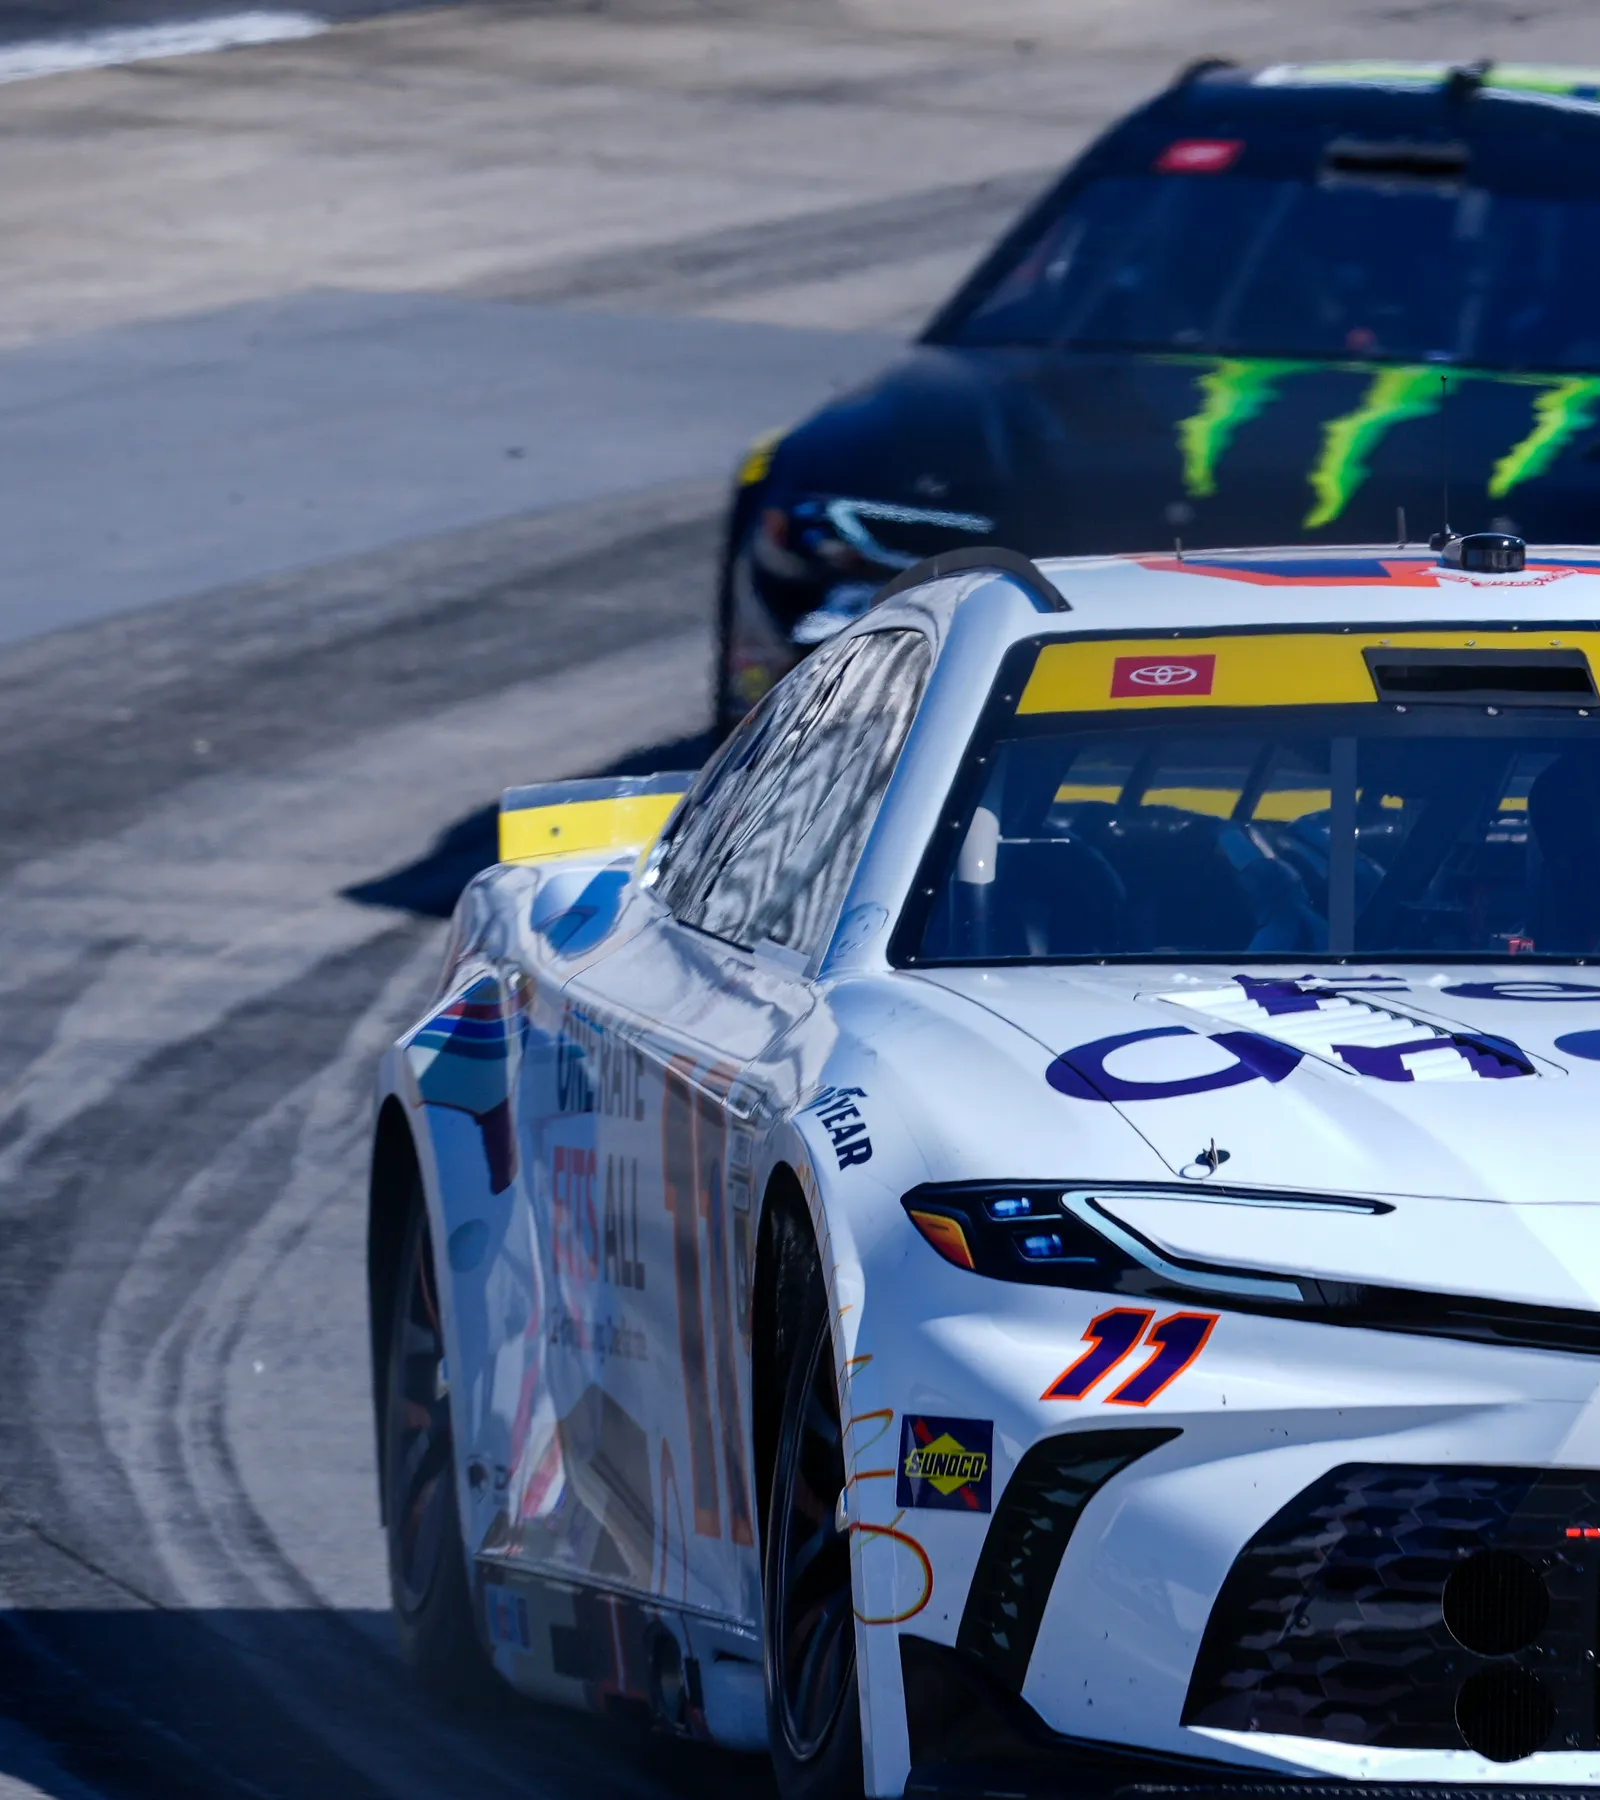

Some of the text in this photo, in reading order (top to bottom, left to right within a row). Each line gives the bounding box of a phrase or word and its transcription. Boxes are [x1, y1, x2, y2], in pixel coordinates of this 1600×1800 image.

[604, 1152, 646, 1291] ALL
[1040, 1306, 1221, 1407] 11
[910, 1451, 984, 1478] SUNOCO
